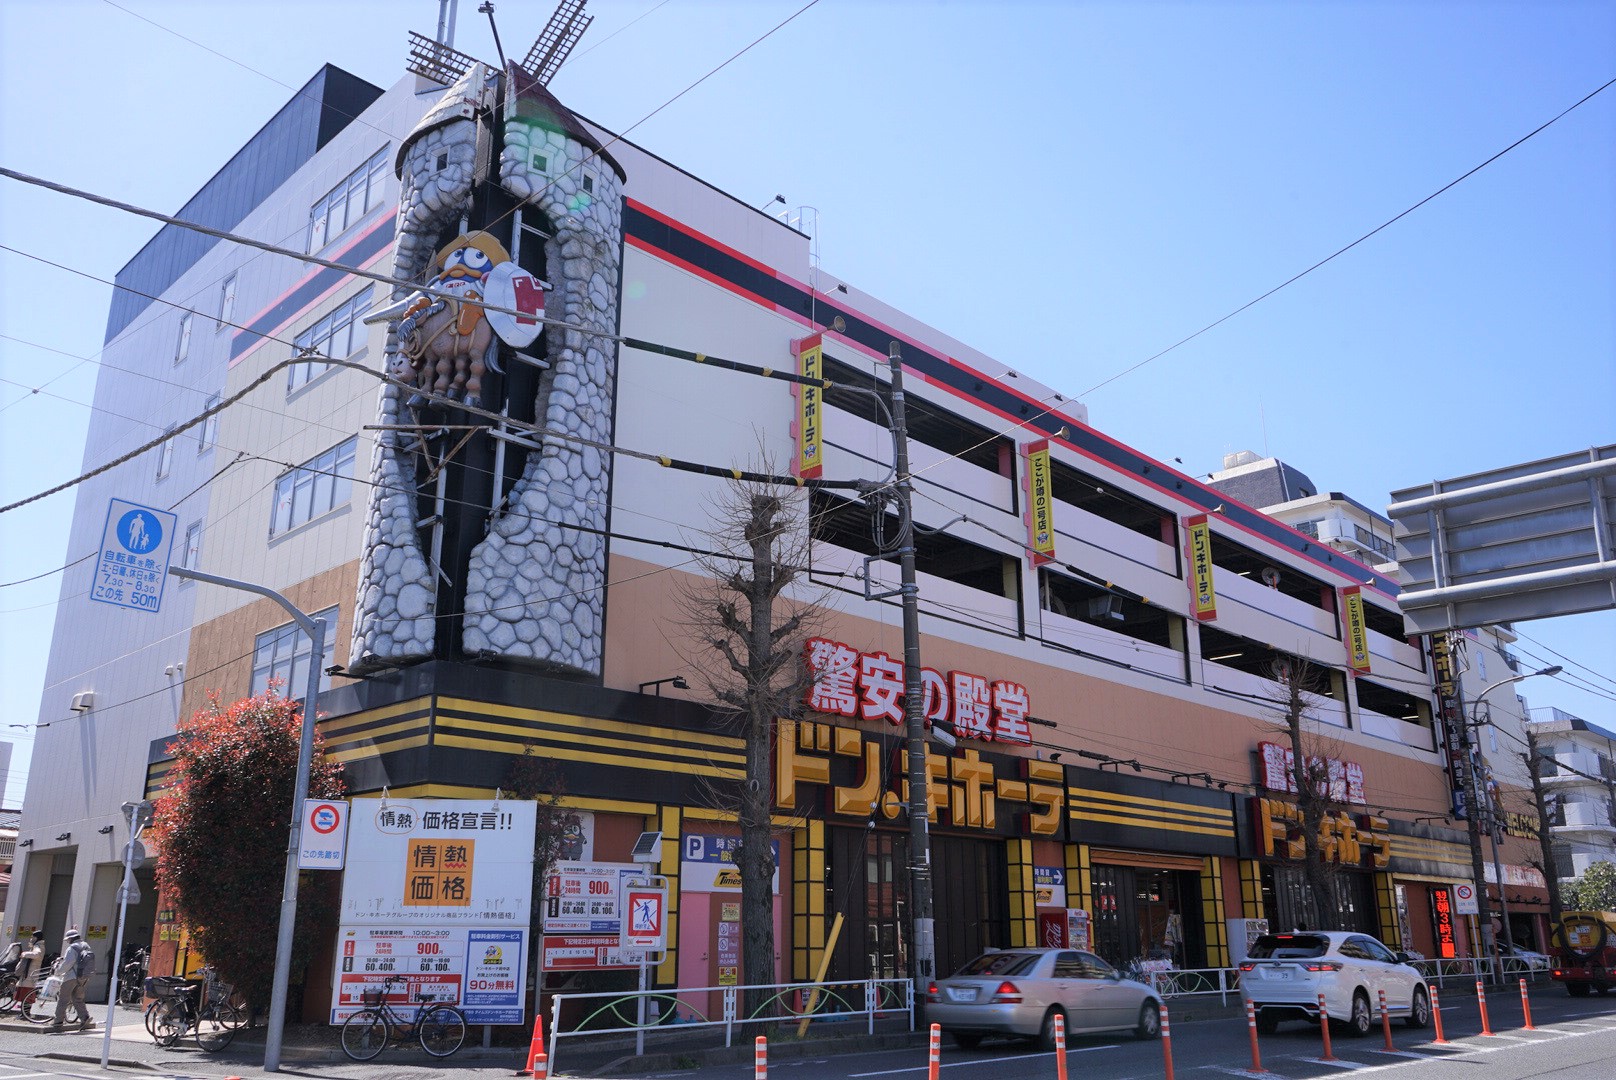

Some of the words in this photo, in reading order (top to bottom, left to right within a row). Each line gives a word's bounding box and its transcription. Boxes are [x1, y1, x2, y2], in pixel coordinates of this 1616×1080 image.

[104, 549, 162, 572] 自転車を除く
[96, 585, 124, 602] この先
[131, 591, 157, 609] 50m
[805, 637, 1032, 747] 驚安の殿堂
[380, 811, 412, 829] 情熱
[422, 811, 513, 830] 価格宣言!!
[303, 850, 340, 860] この先踏切
[719, 871, 742, 885] Times
[469, 980, 514, 990] 90分無料
